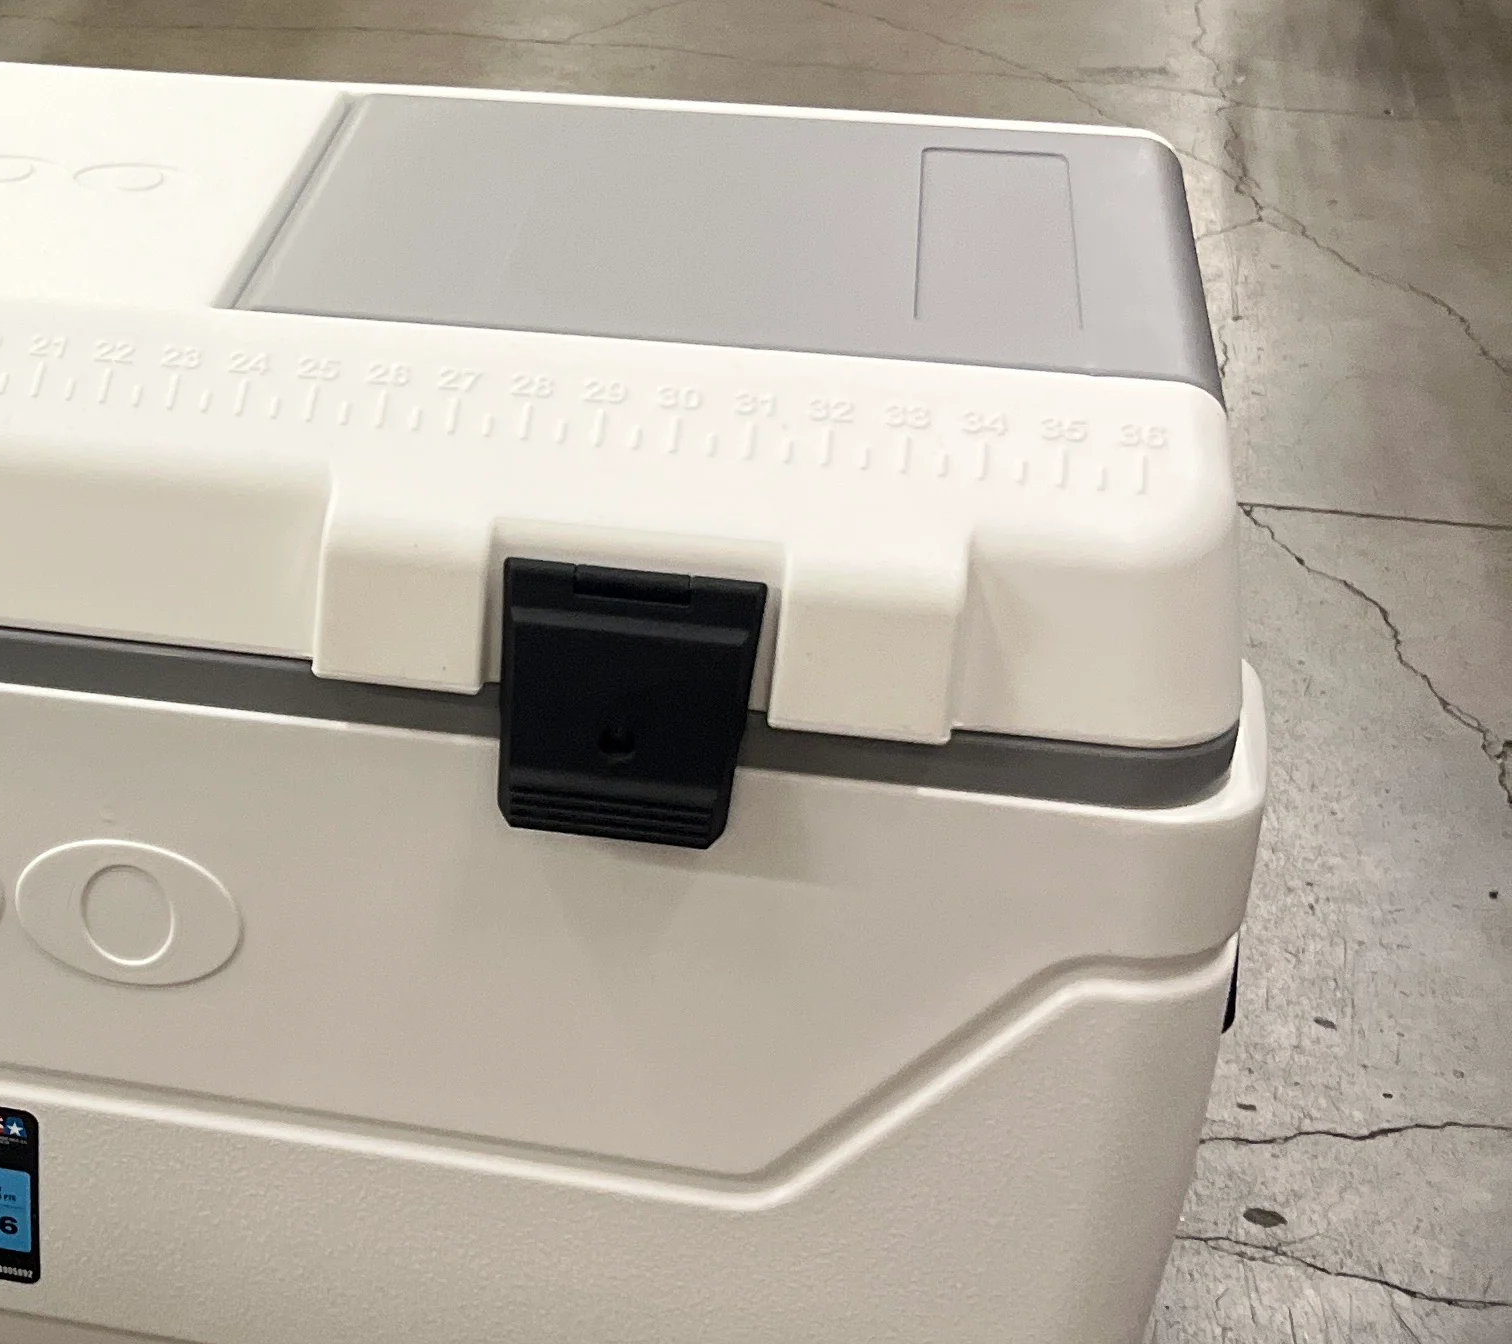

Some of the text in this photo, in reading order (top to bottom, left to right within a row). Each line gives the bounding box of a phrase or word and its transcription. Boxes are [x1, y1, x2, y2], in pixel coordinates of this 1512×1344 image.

[29, 333, 70, 358] 21
[93, 339, 136, 365] 22
[161, 344, 204, 370] 23
[228, 350, 273, 376] 24
[296, 357, 342, 382] 25
[366, 362, 412, 387] 26
[438, 366, 484, 393] 27
[510, 373, 555, 399] 28
[582, 378, 629, 405] 29
[657, 384, 704, 412] 30
[735, 391, 779, 418] 31
[808, 397, 856, 424] 32
[884, 402, 933, 430] 33
[962, 409, 1010, 438] 34
[1039, 415, 1089, 444] 35
[1118, 422, 1169, 450] 36
